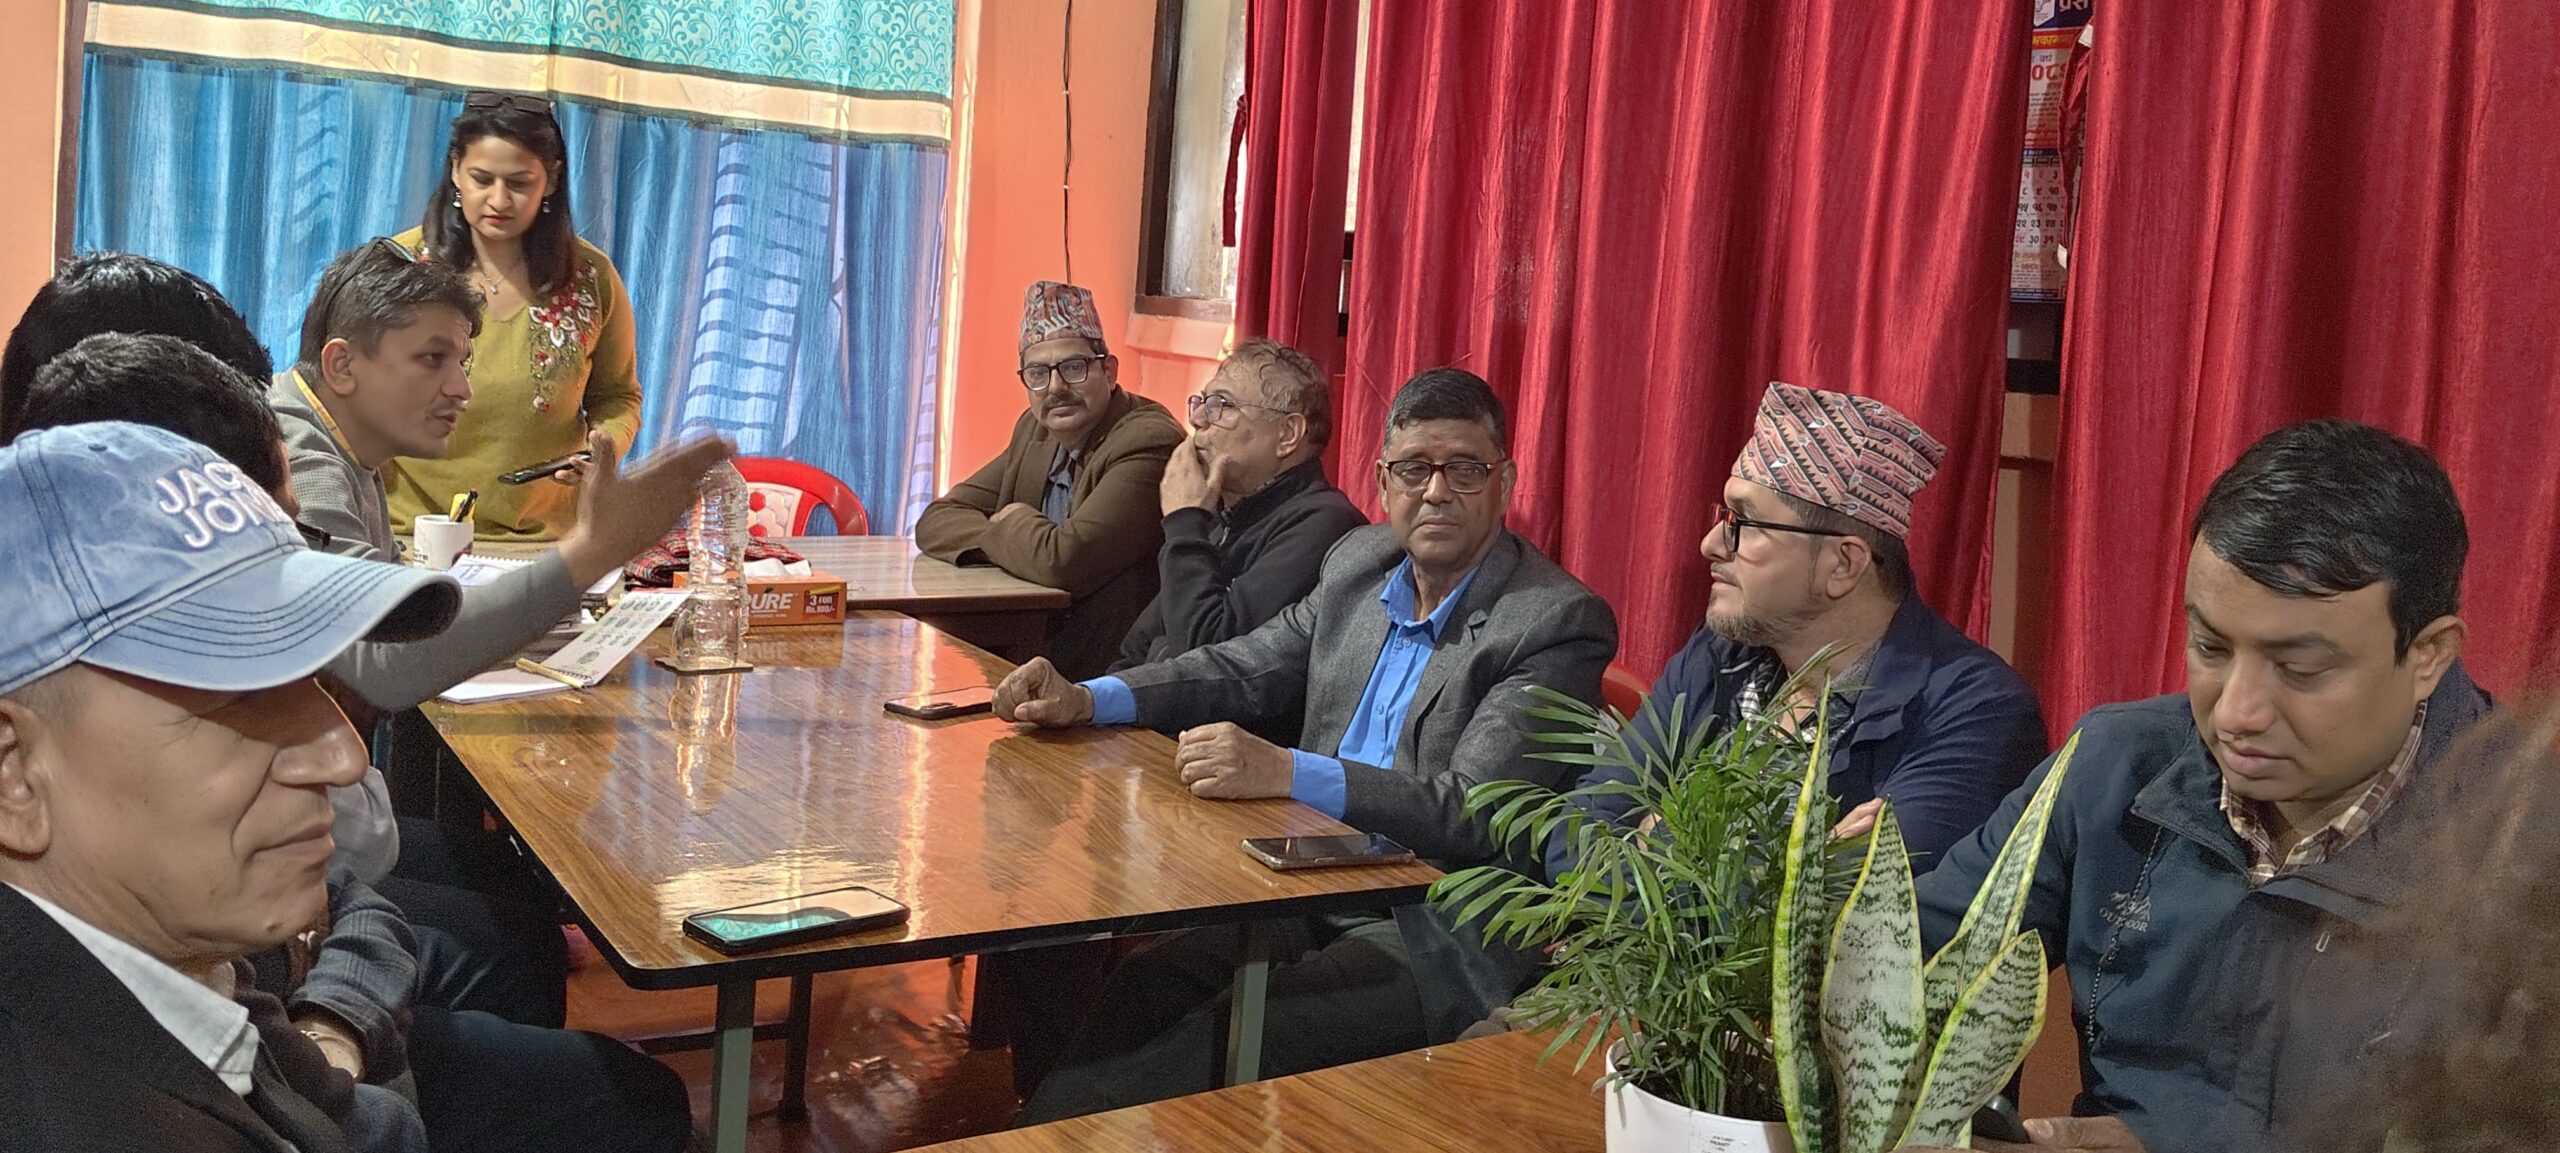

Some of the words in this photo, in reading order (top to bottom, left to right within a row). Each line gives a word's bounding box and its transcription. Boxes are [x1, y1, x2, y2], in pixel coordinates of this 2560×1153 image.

[155, 462, 247, 514] JAC
[184, 486, 293, 549] JON
[748, 593, 794, 609] URE
[810, 595, 818, 606] 3
[818, 596, 833, 604] FOR
[2099, 906, 2148, 932] OUTOOR
